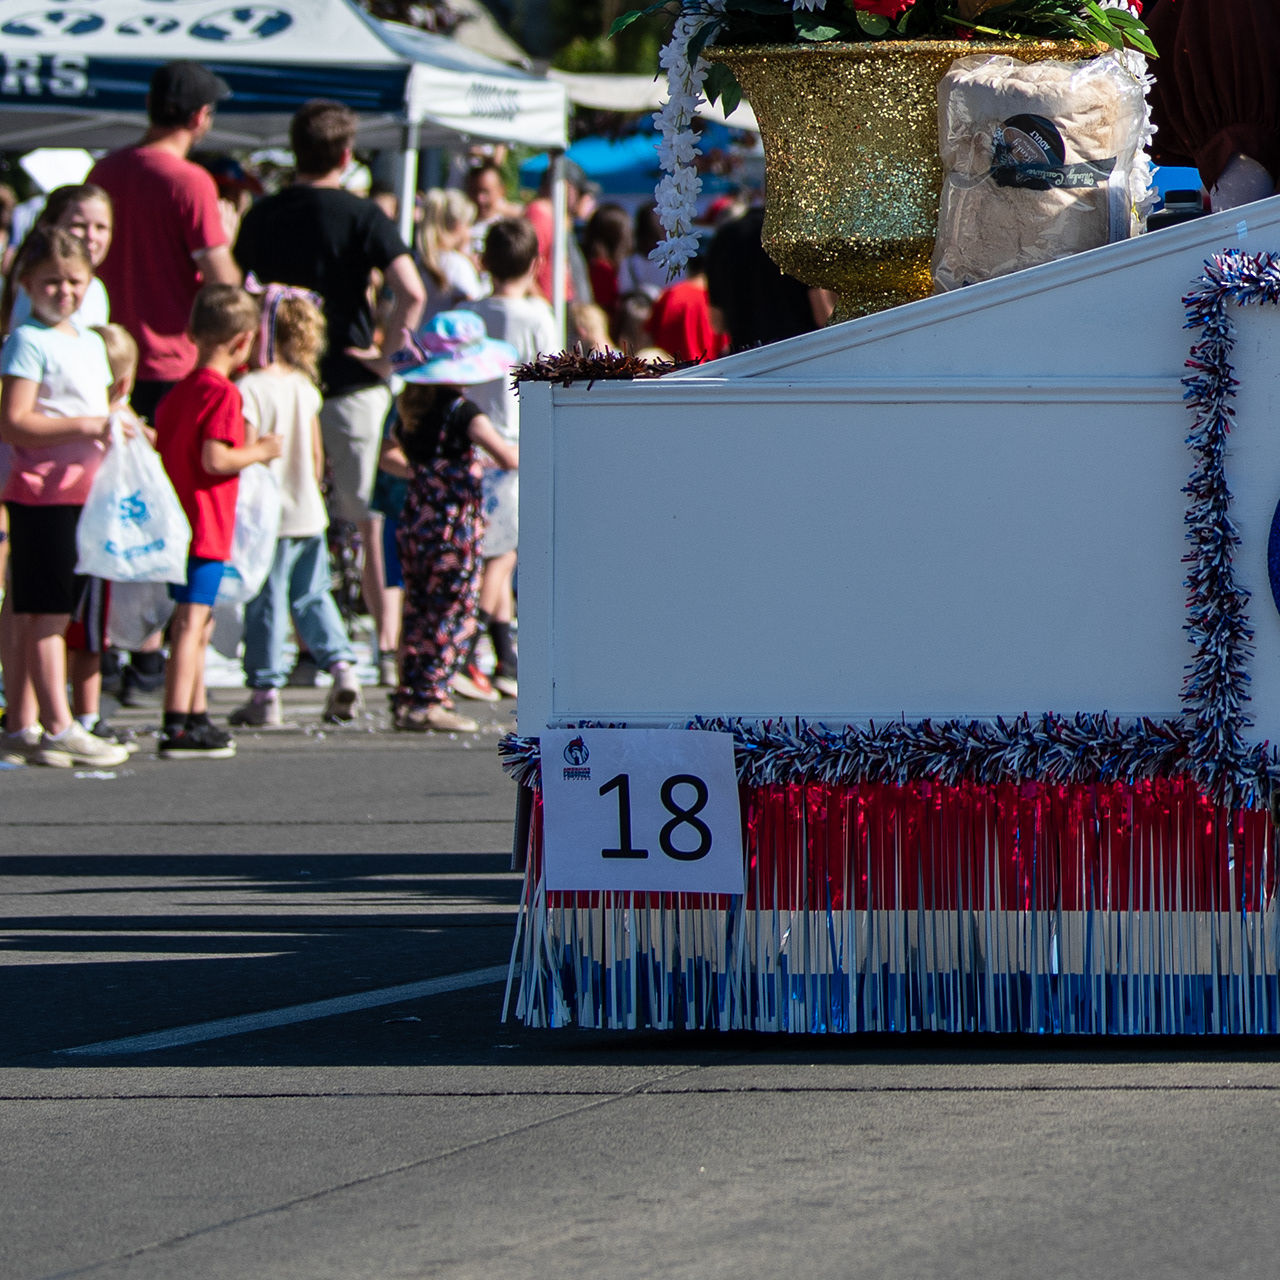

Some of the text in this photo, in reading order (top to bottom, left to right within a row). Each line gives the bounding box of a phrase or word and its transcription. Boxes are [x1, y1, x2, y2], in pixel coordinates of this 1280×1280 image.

[1029, 130, 1051, 151] ADULT
[1026, 168, 1065, 186] Couture
[1066, 168, 1095, 186] Minky
[599, 773, 713, 861] 18
